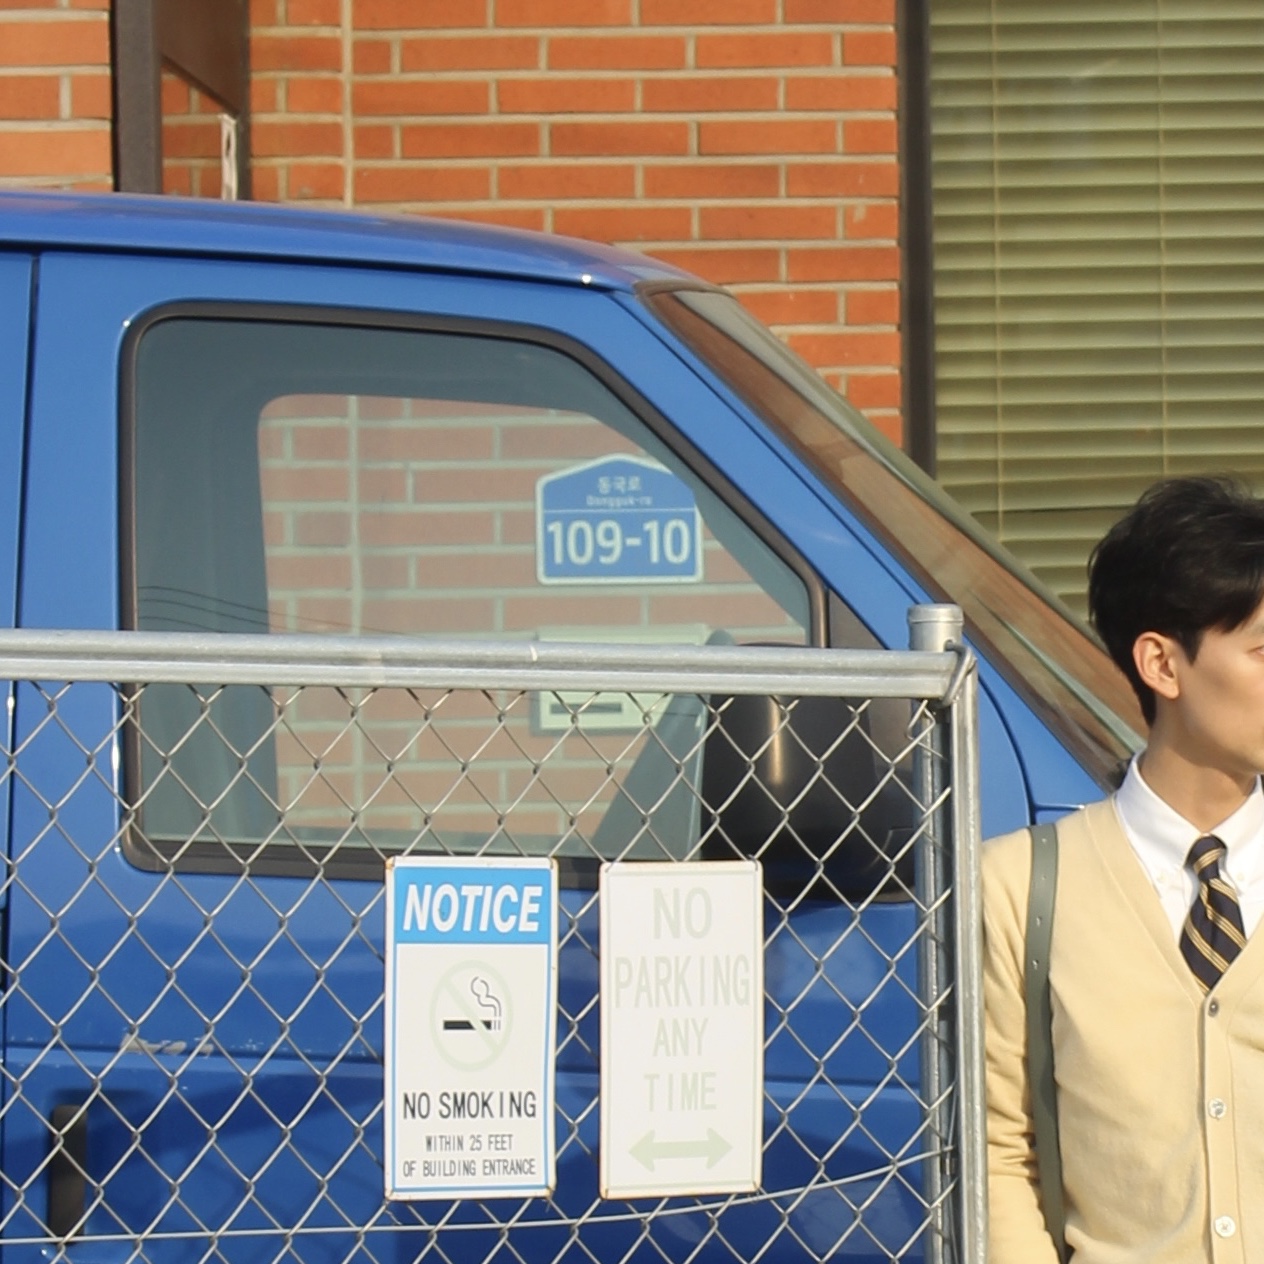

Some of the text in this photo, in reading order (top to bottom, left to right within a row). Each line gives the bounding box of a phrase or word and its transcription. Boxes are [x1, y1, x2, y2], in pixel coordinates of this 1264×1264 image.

[547, 518, 691, 566] 109-10
[402, 883, 543, 934] NOTICE
[652, 886, 713, 940] NO
[613, 953, 751, 1010] PARKING
[651, 1017, 709, 1057] ANY
[402, 1090, 537, 1120] NO SMOKING
[643, 1070, 718, 1112] TIME
[425, 1133, 514, 1153] WITHIN 25 FEET
[402, 1157, 536, 1178] OF BUILDING ENTRANCE
